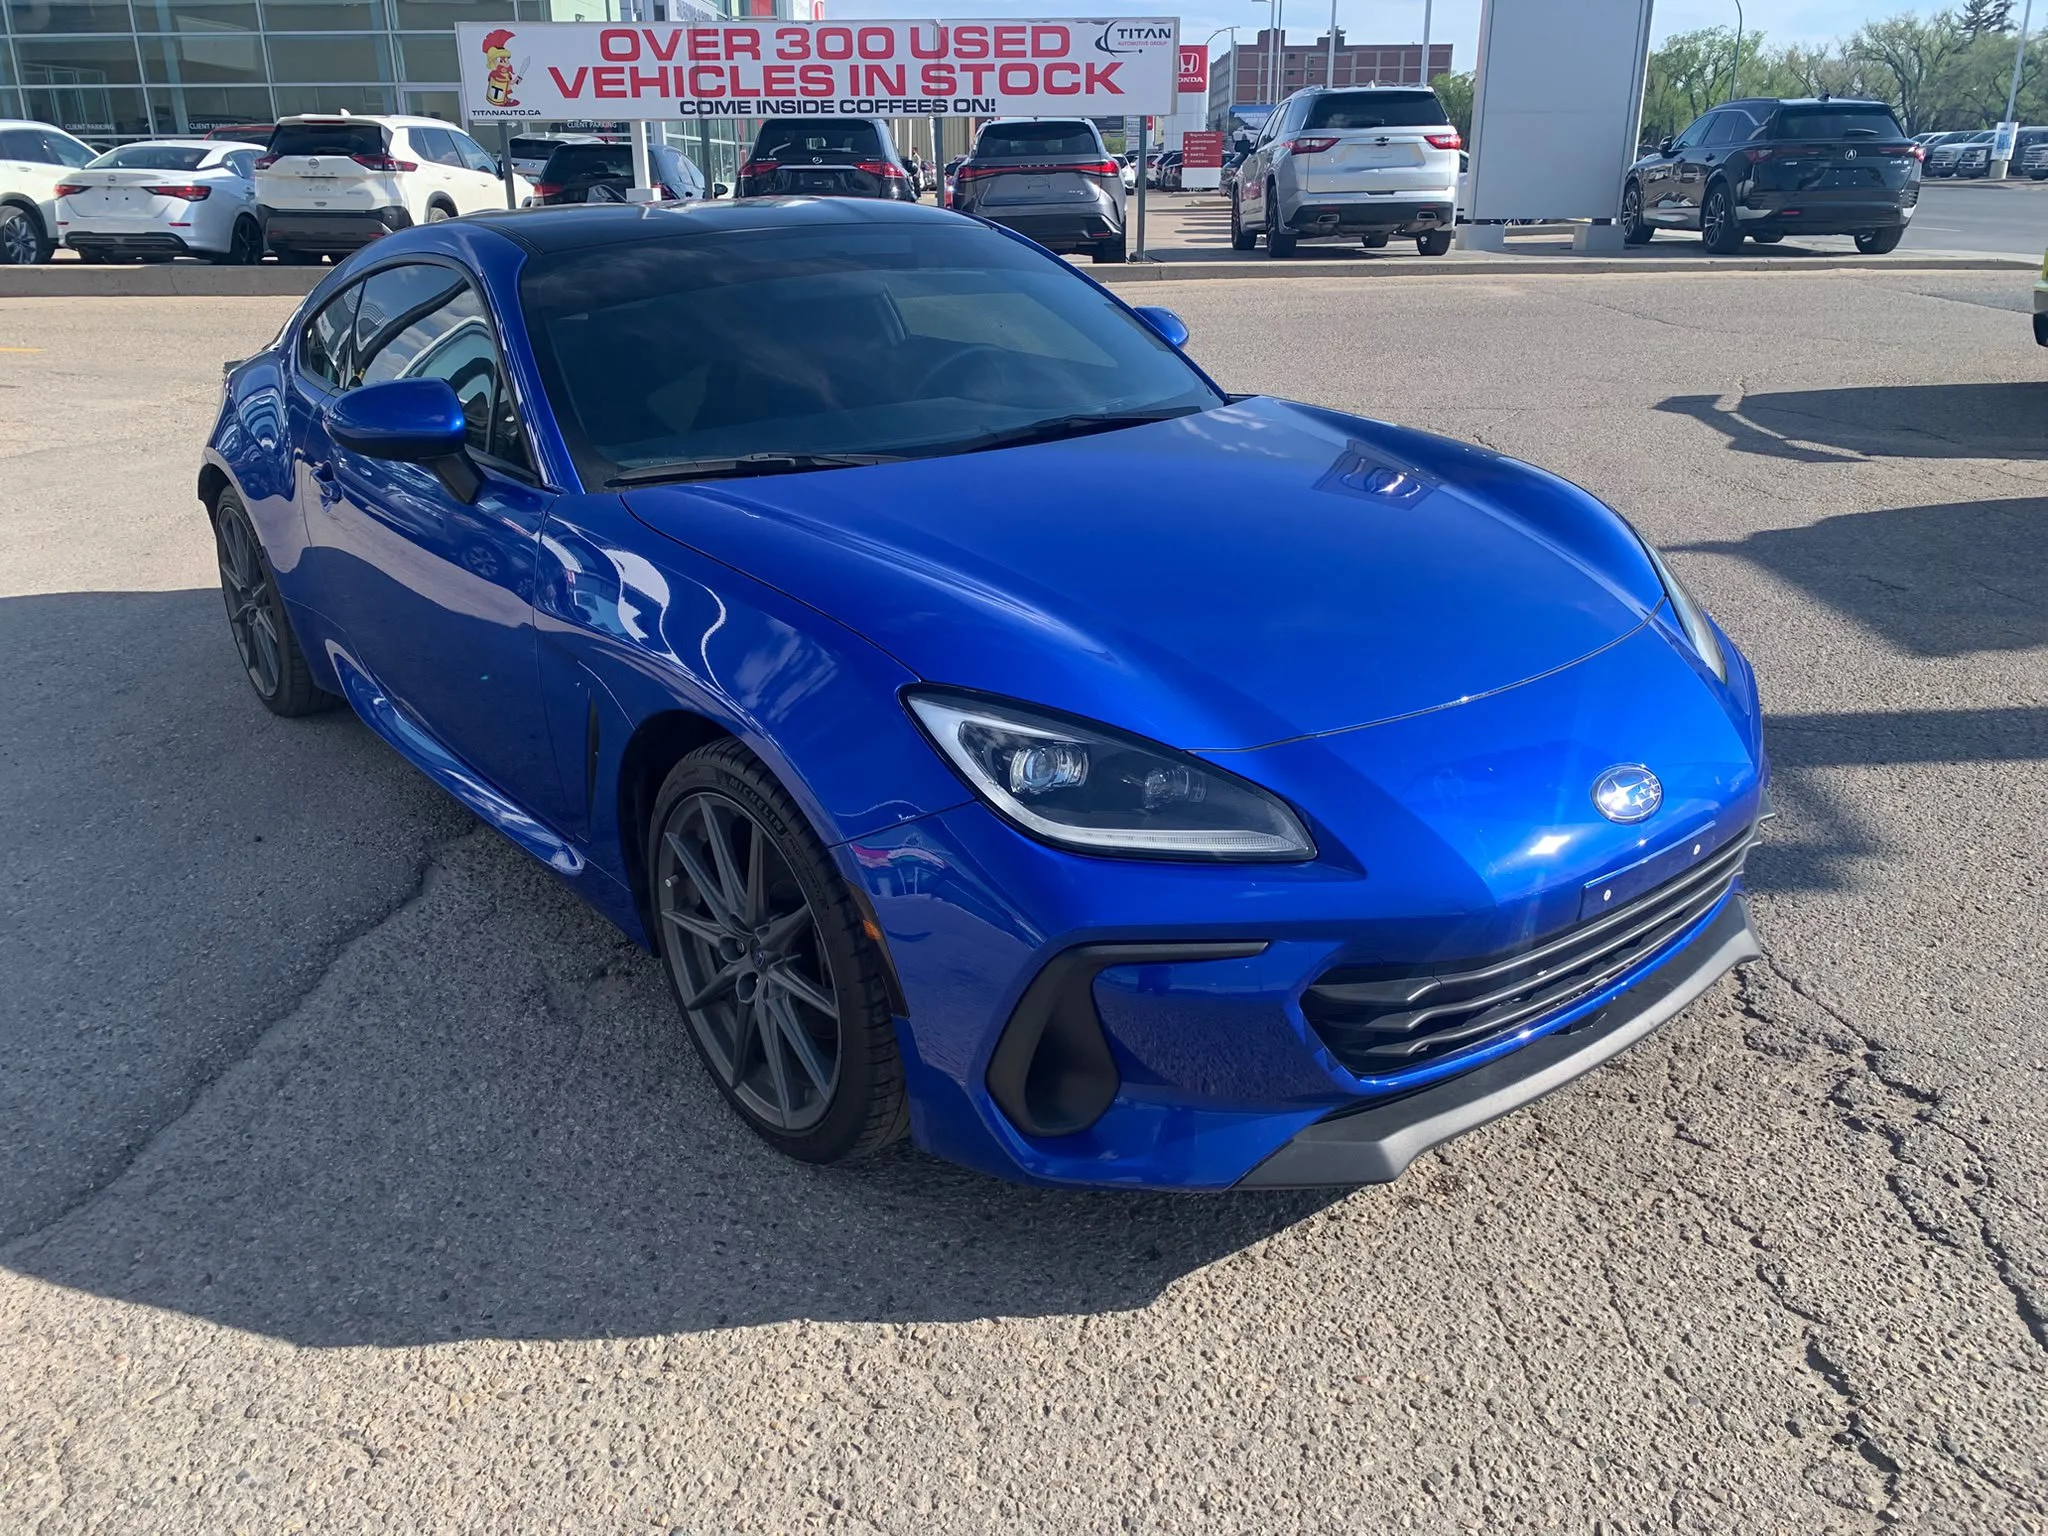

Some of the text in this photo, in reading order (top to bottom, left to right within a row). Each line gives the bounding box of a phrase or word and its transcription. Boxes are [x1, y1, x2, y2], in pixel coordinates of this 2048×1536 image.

[600, 26, 1071, 62] OVER 300 USED
[1117, 28, 1171, 39] TITAN
[547, 62, 1125, 99] VEHICLES IN STOCK
[680, 98, 996, 115] COME INSIDE COFFEES ON!
[728, 778, 784, 831] MICHELIN
